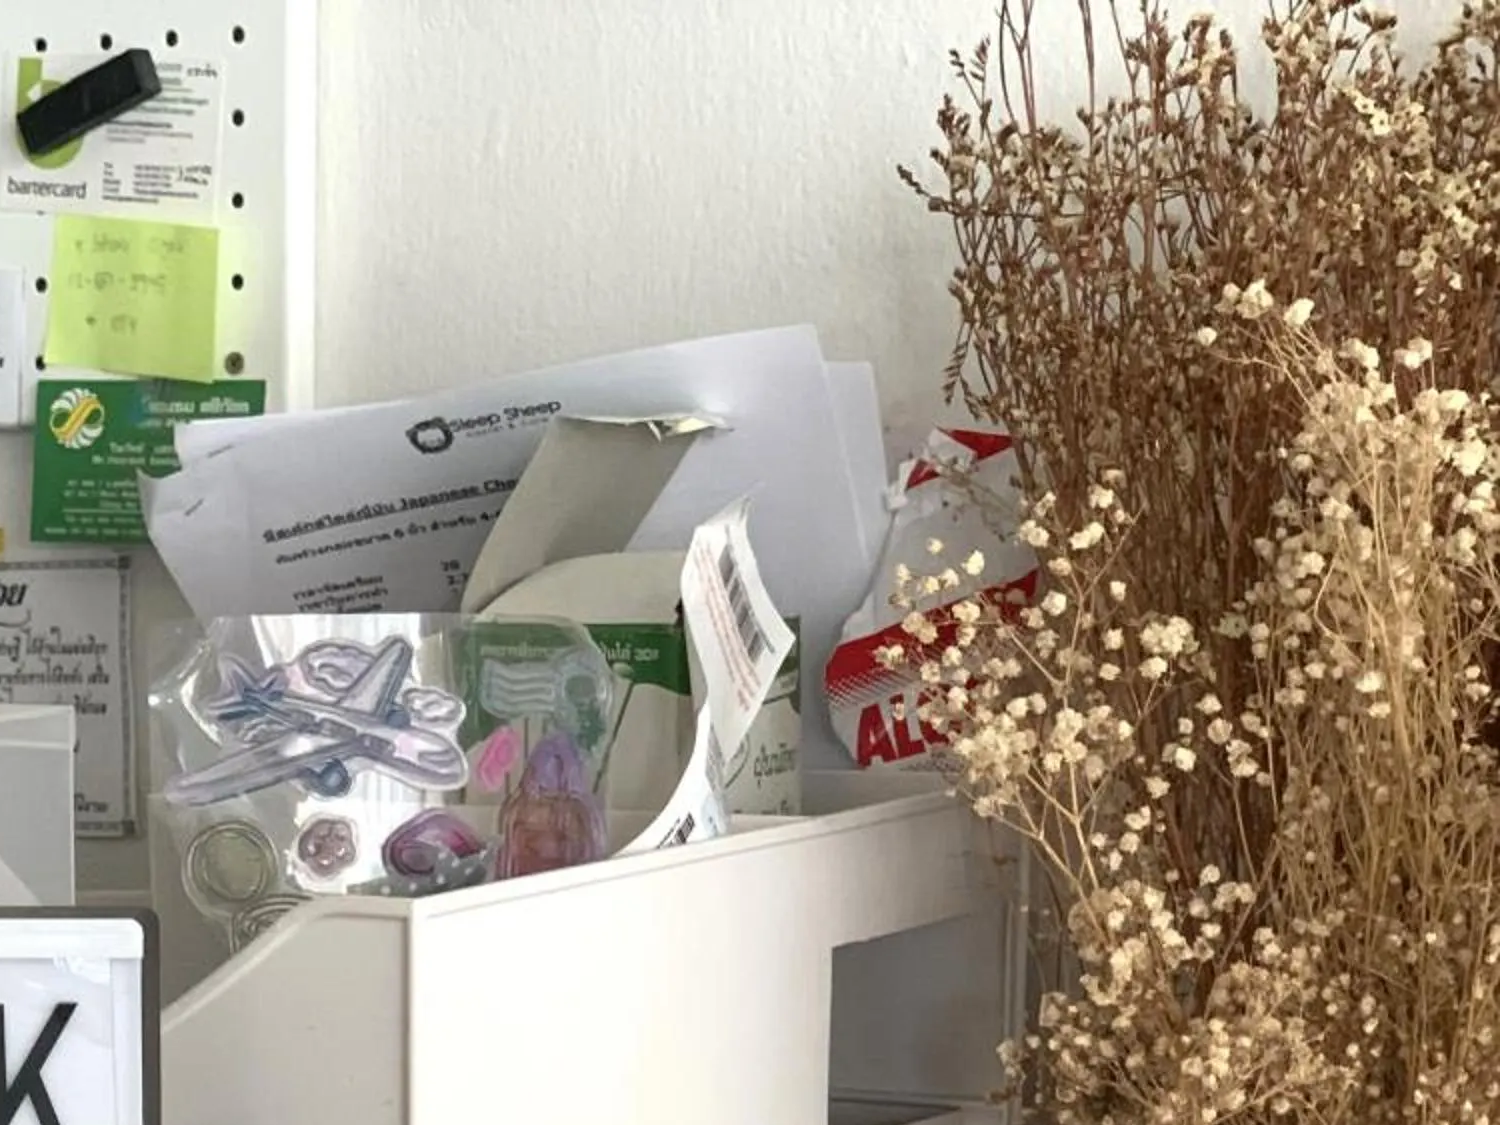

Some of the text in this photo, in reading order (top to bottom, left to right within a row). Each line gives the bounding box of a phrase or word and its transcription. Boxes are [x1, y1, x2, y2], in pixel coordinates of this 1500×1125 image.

[7, 176, 88, 200] bartercard
[503, 400, 562, 419] Sheep
[400, 485, 479, 512] Japanese
